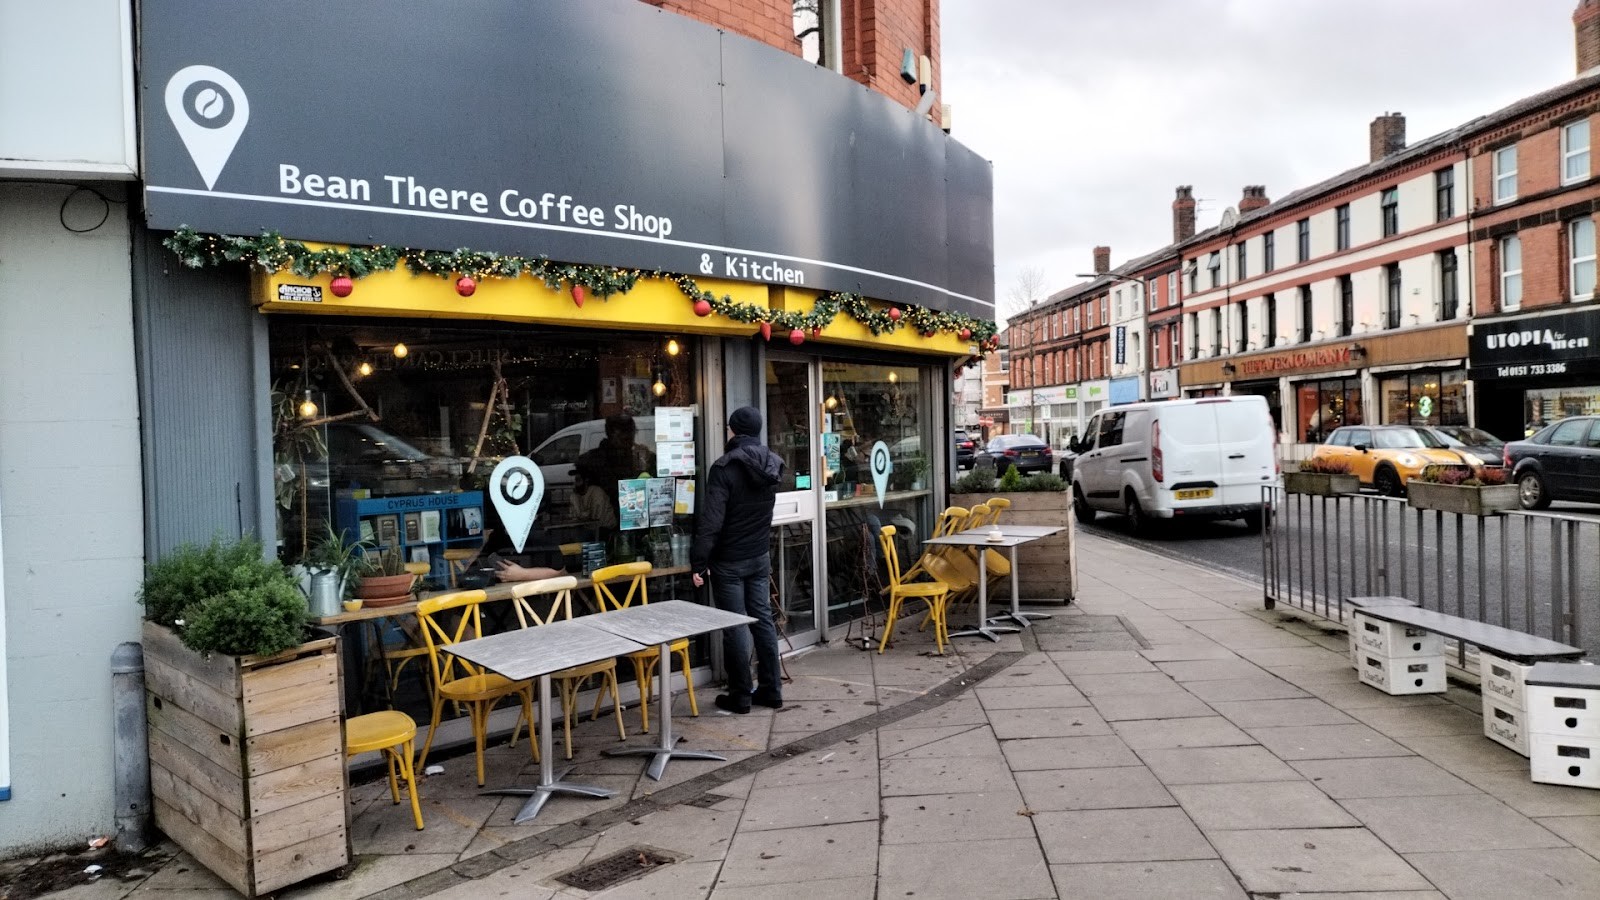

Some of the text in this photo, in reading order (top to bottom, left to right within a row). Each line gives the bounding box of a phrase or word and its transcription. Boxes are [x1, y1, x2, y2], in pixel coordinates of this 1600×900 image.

[279, 163, 673, 239] Bean There Coffee Shop
[700, 253, 805, 285] & Kitchen
[279, 284, 312, 294] ANCHOR
[1486, 329, 1589, 350] UTOPIA for men
[1258, 354, 1295, 371] TAVERN
[1296, 348, 1350, 367] COMPANY
[1497, 363, 1566, 377] Tel 0151 733 3386
[388, 495, 459, 509] CYPRUS HOUSE
